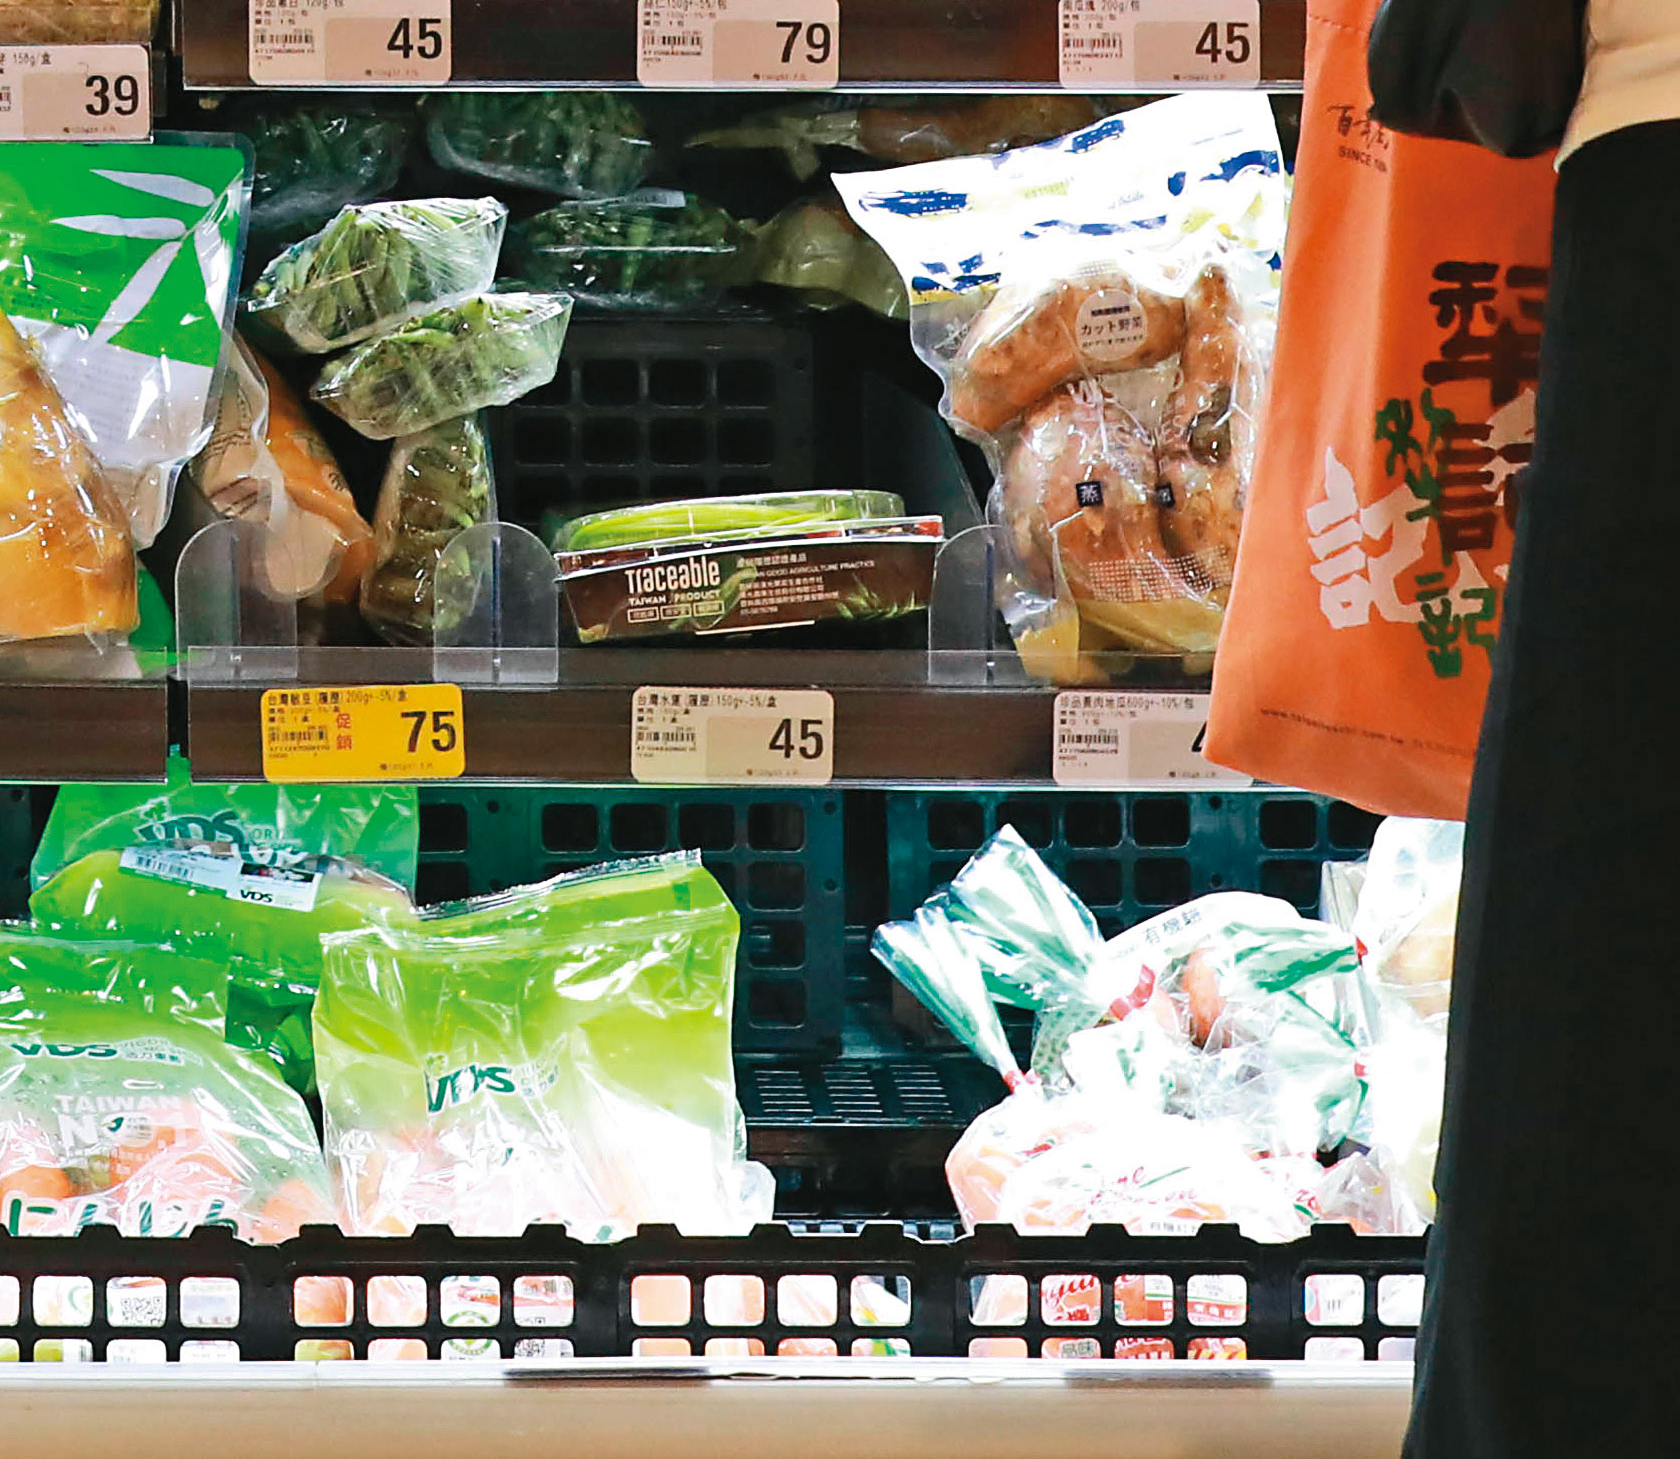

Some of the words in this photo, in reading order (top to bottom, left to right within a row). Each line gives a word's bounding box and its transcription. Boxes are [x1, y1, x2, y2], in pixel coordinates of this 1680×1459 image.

[387, 18, 442, 59] 45
[776, 22, 830, 63] 79
[1196, 23, 1249, 63] 45
[86, 75, 138, 115] 39
[1337, 146, 1373, 167] SINCE
[1080, 317, 1144, 337] カット野菜
[625, 555, 721, 595] Traceable
[628, 595, 666, 606] TAIWAN
[673, 589, 721, 603] PRODUCT
[335, 713, 353, 751] 促銷
[401, 711, 455, 752] 75
[769, 719, 823, 759] 45
[240, 889, 274, 903] VDS
[10, 1042, 118, 1059] VDS
[56, 1093, 179, 1111] TAIWAN
